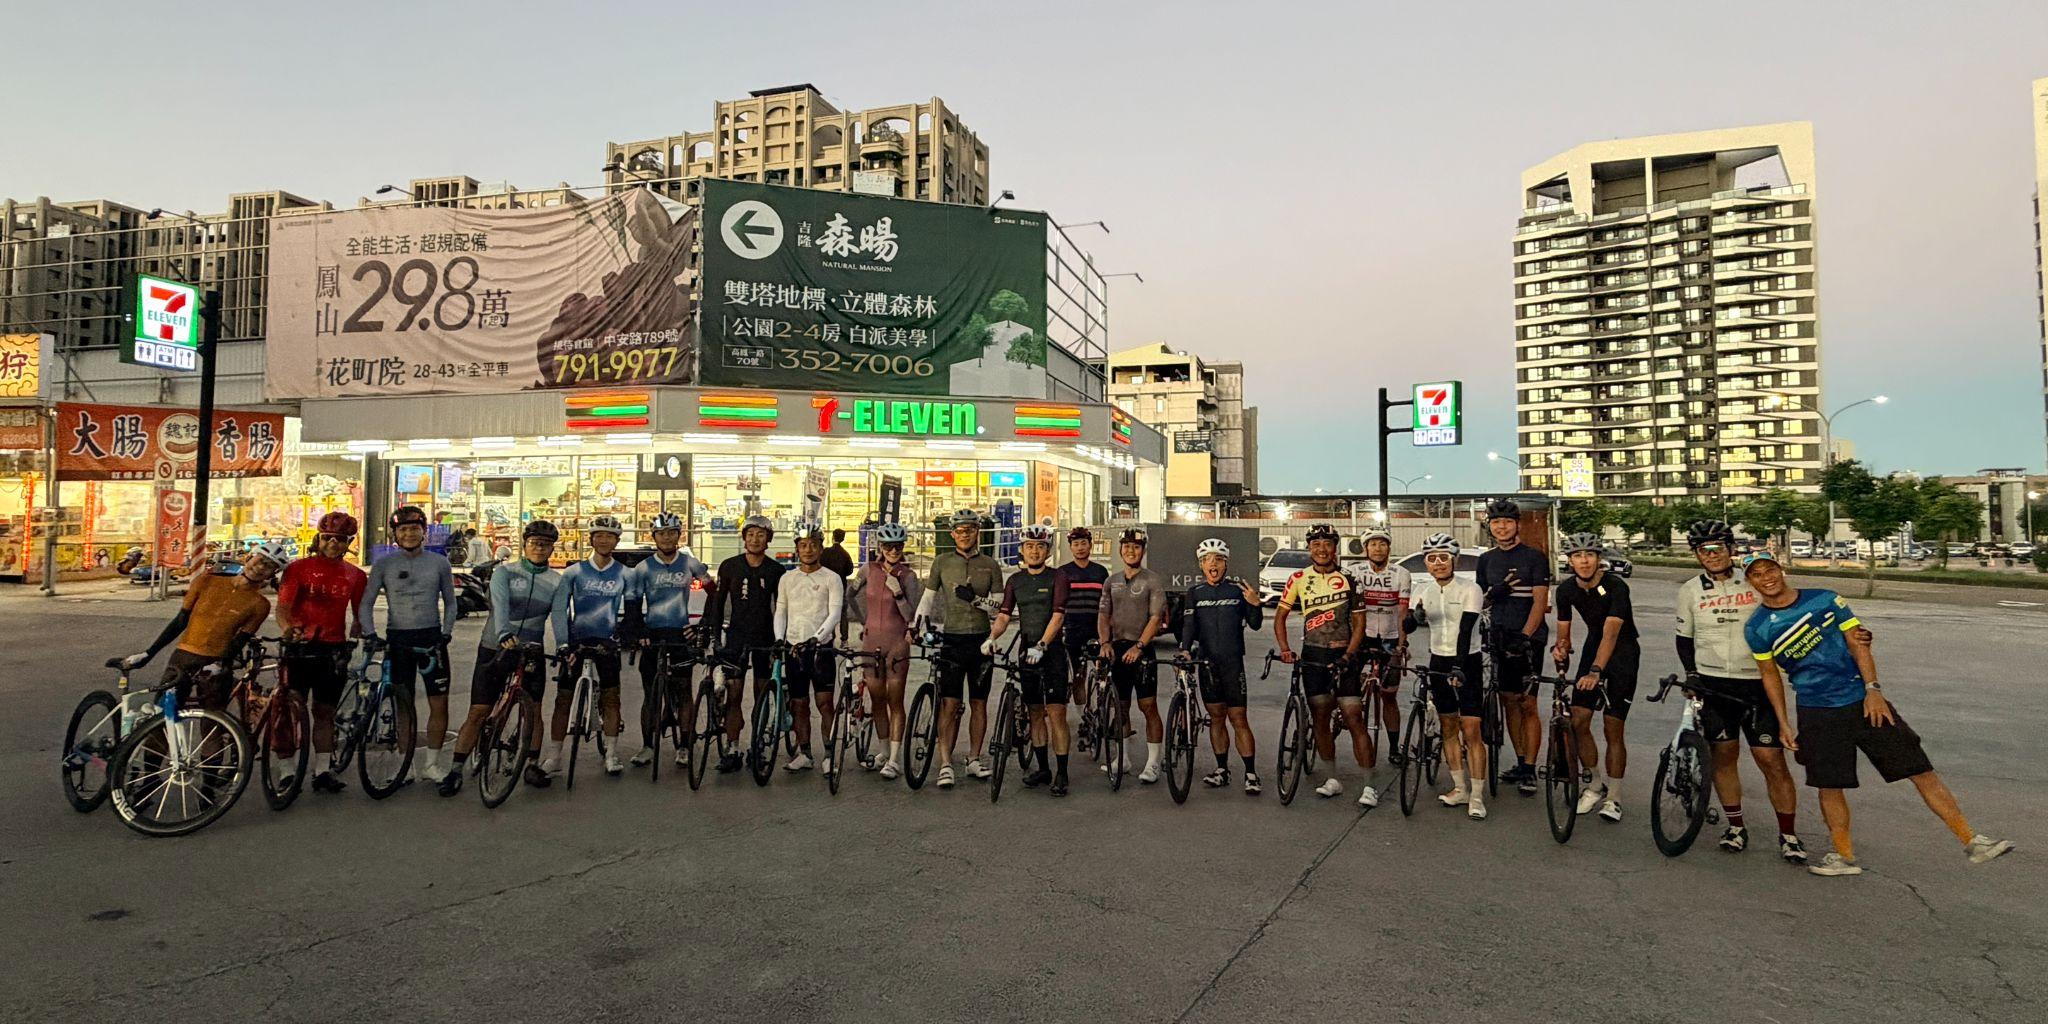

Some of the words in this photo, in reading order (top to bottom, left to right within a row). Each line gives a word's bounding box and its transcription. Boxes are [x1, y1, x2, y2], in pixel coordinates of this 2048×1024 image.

[797, 221, 812, 248] 吉隆
[822, 260, 857, 270] NATURAL
[859, 264, 893, 273] MANSION
[604, 328, 680, 347] 中安路789號
[850, 324, 928, 348] 白派美學
[326, 356, 405, 387] 花町院
[553, 346, 678, 383] 791-9977
[779, 348, 935, 377] 352-7006
[1363, 575, 1391, 587] UAE
[1699, 591, 1754, 609] FACTOR
